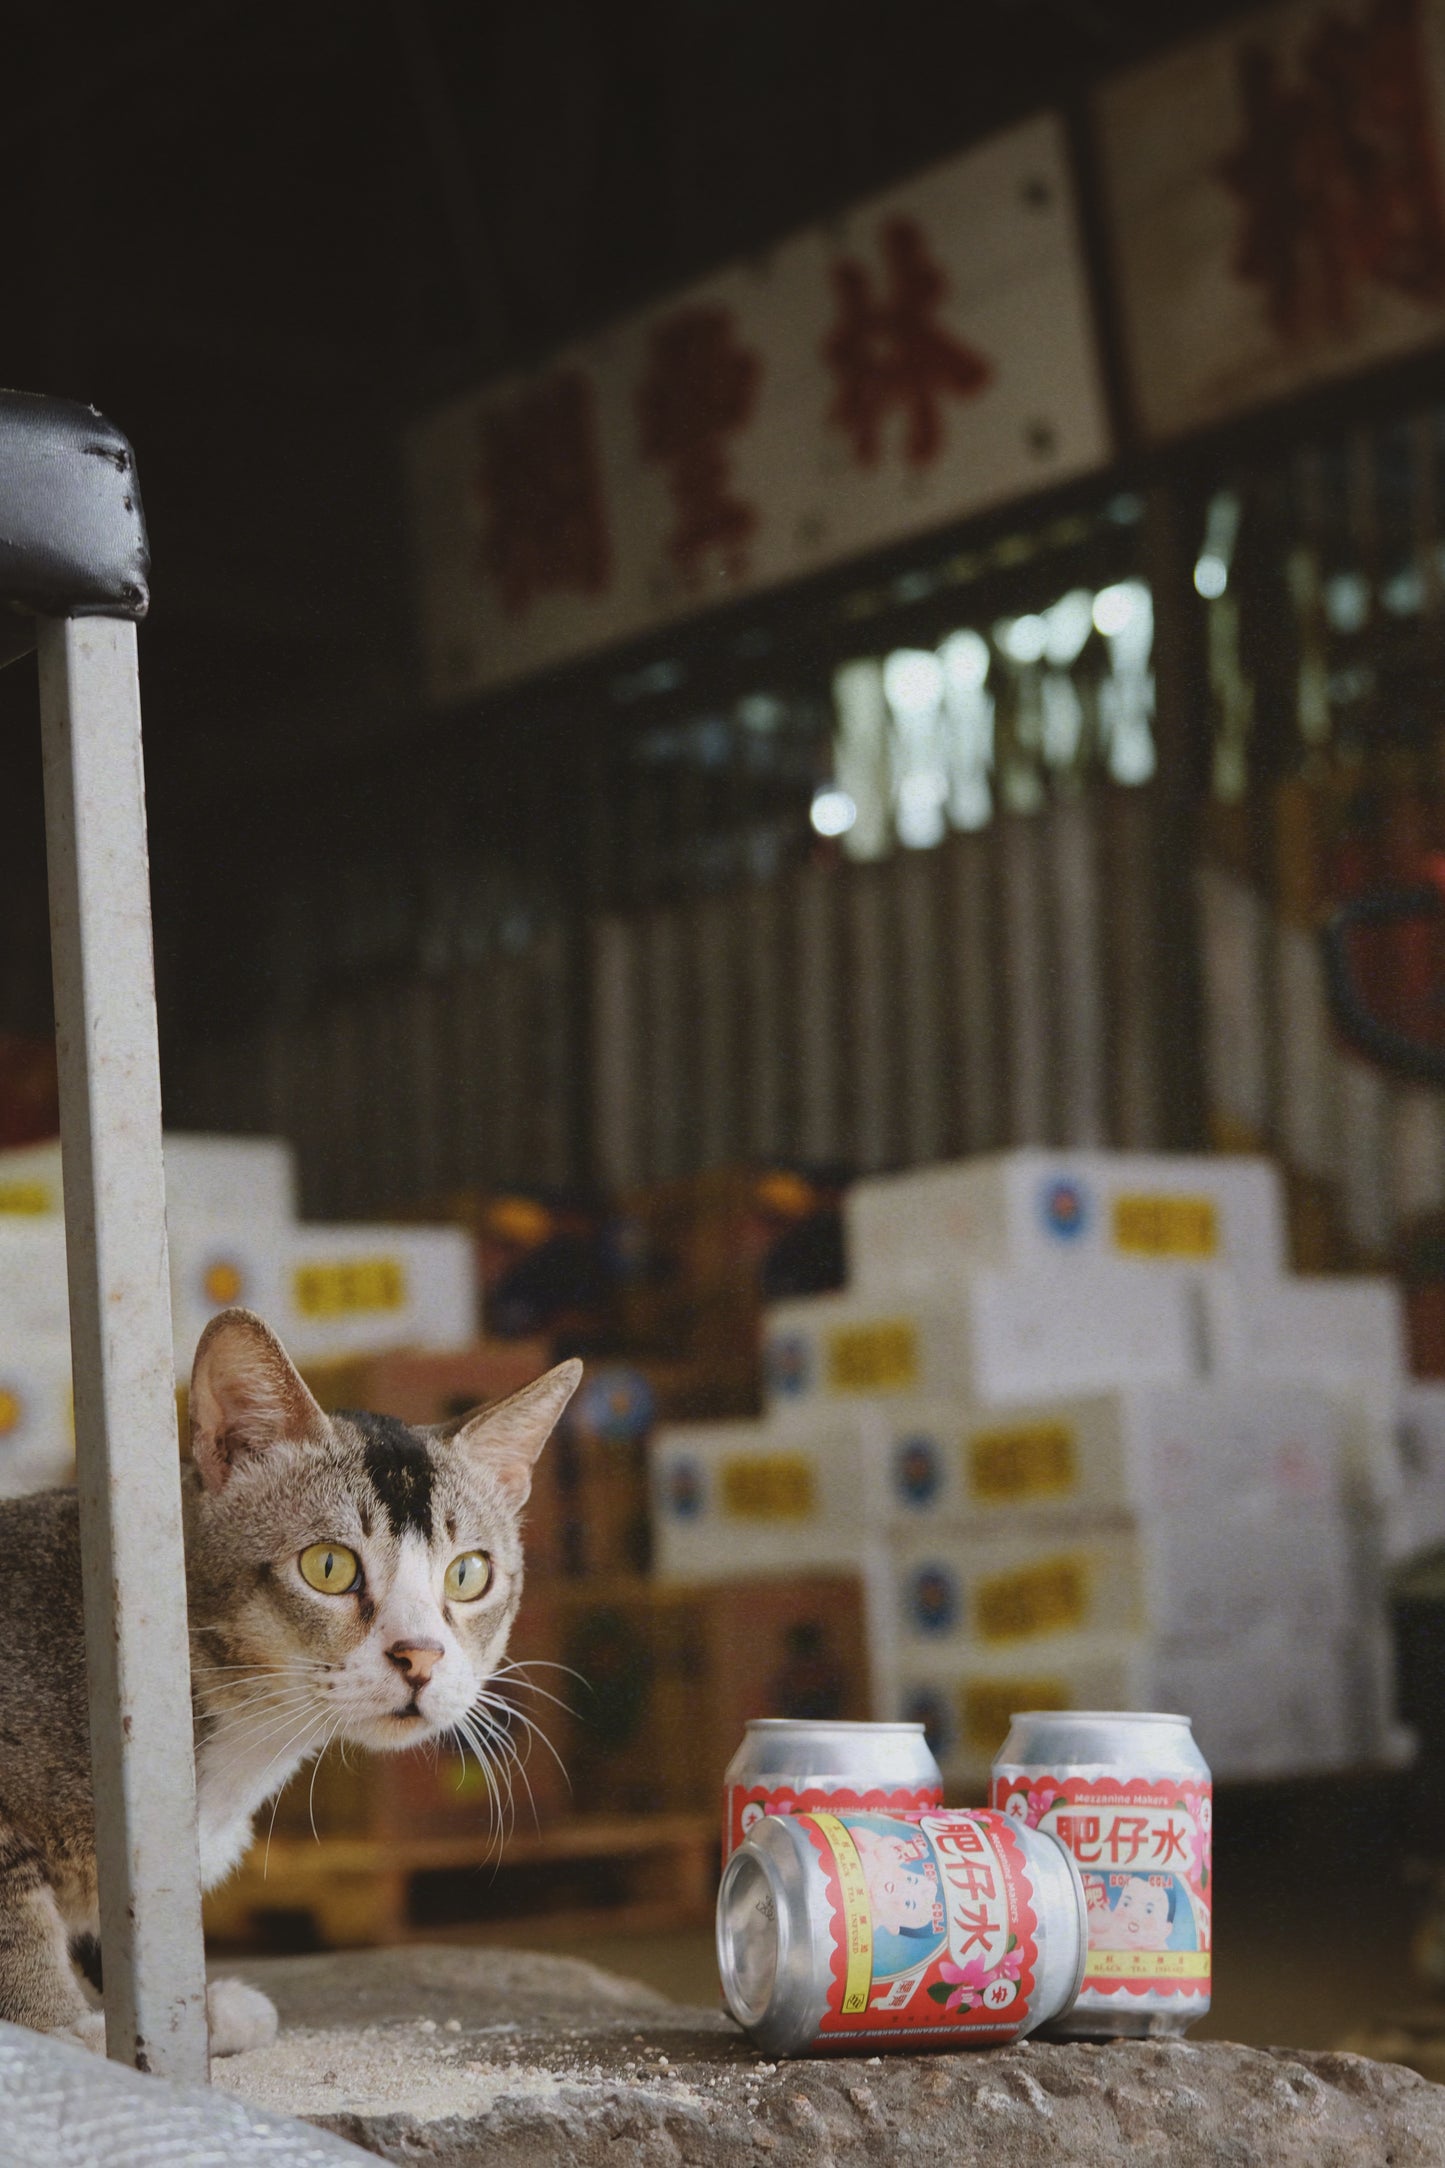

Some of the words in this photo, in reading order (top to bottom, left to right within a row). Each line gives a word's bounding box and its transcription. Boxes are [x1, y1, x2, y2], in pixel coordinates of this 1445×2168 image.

[1075, 1794, 1130, 1806] Mezzanine
[1133, 1794, 1168, 1806] Makers
[1056, 1816, 1188, 1865] 肥仔水
[991, 1832, 1013, 1881] Mezzanine
[1007, 1882, 1019, 1924] Makers
[1149, 1875, 1174, 1888] COLA
[932, 1822, 1001, 1955] 肥仔水
[847, 1886, 855, 1904] TEA
[851, 1913, 859, 1954] INFUSED
[932, 1903, 945, 1934] COLA
[991, 1986, 1008, 2004] 安
[866, 2028, 901, 2037] MAKERS
[902, 2026, 952, 2035] MEZZANINE
[962, 2024, 994, 2032] MAKERS
